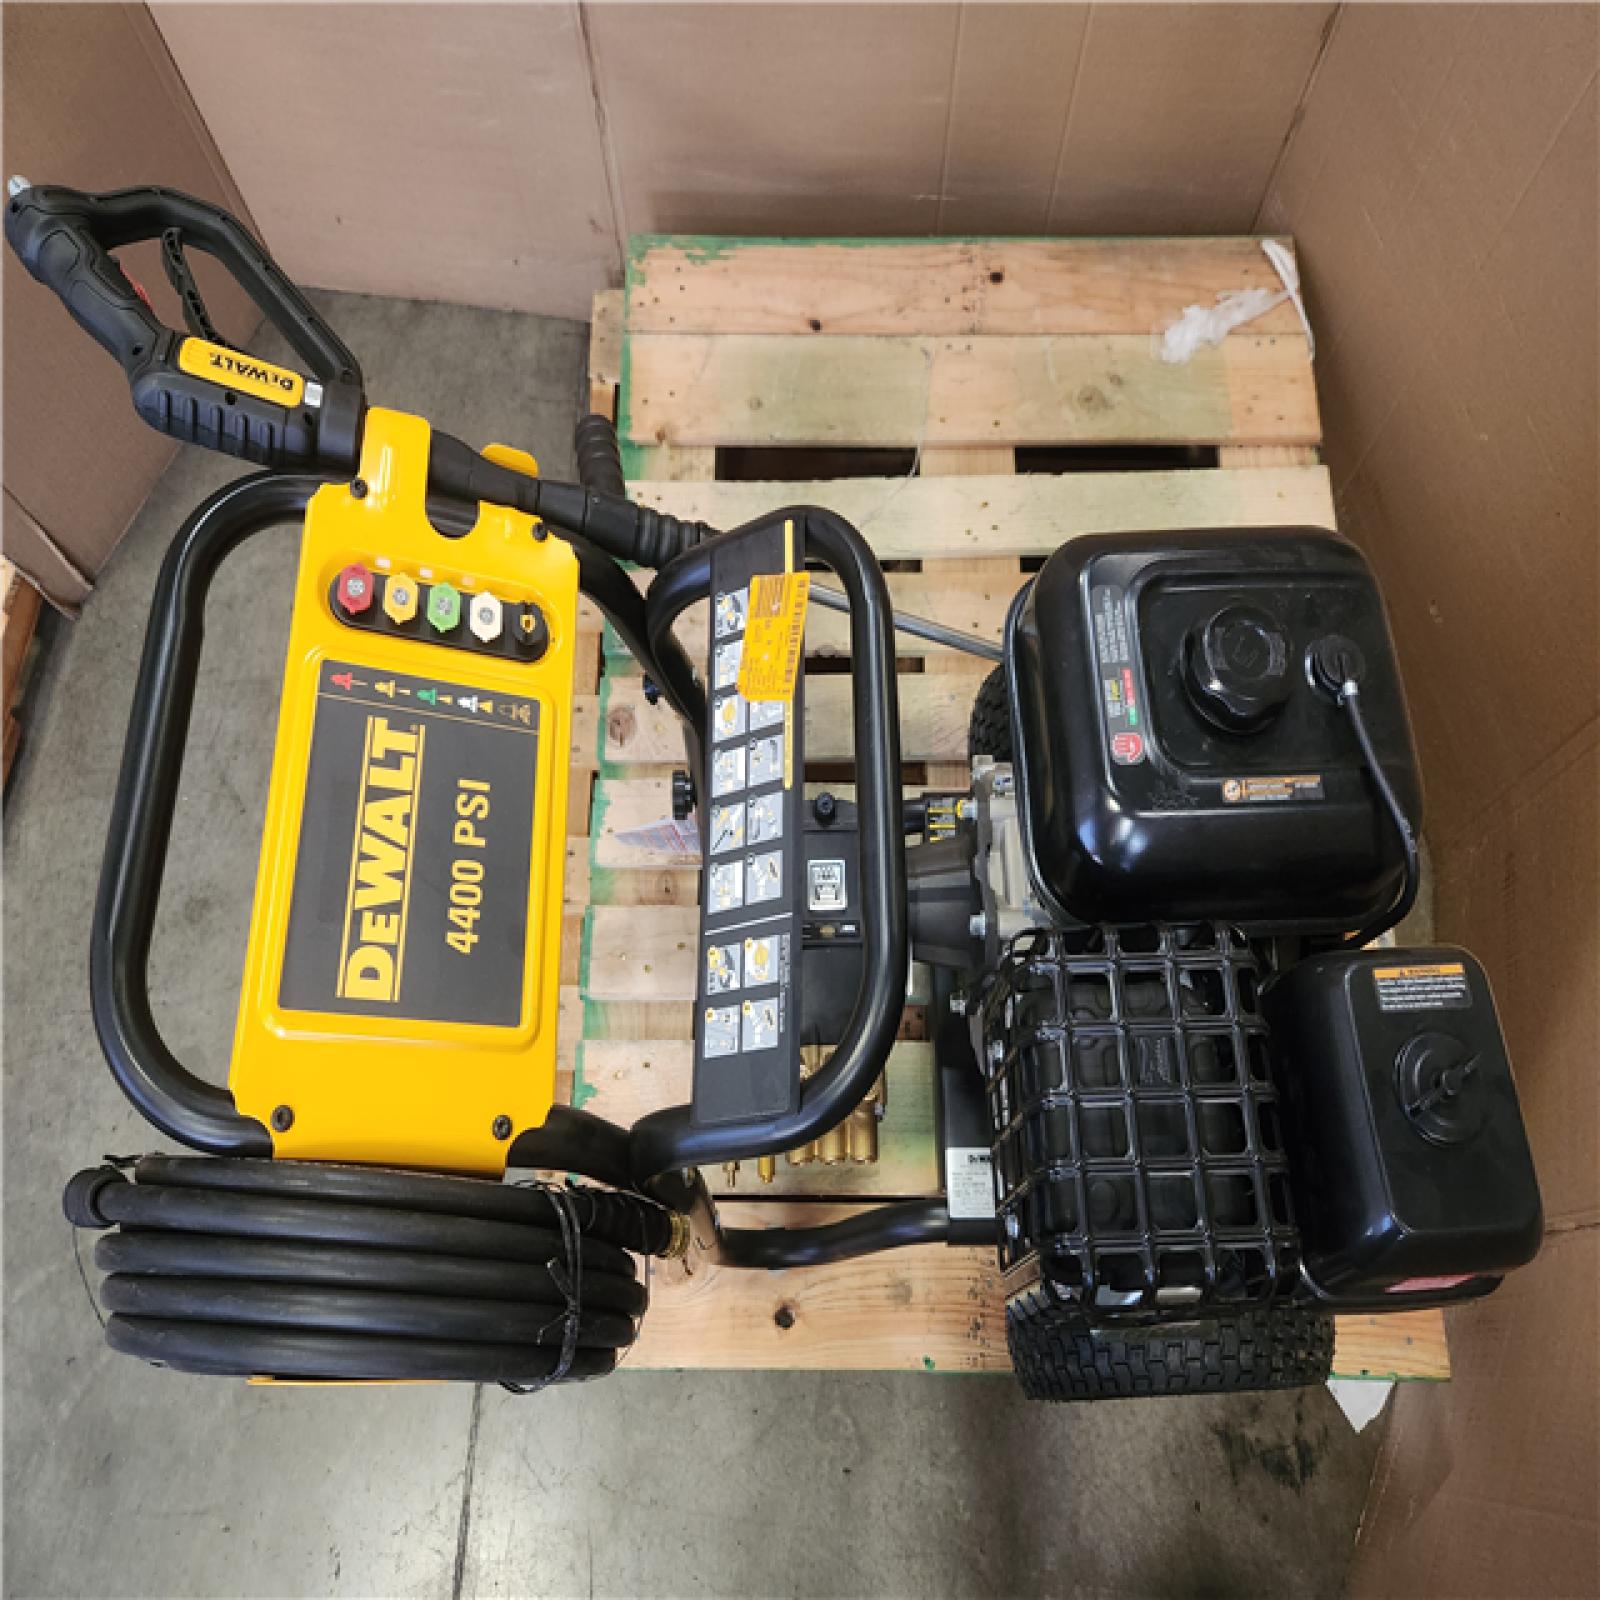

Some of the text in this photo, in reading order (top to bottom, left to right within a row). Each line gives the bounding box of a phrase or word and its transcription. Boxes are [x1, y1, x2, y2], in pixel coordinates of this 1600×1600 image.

[345, 716, 419, 1001] DEWALT
[444, 777, 492, 955] 4400 PSI
